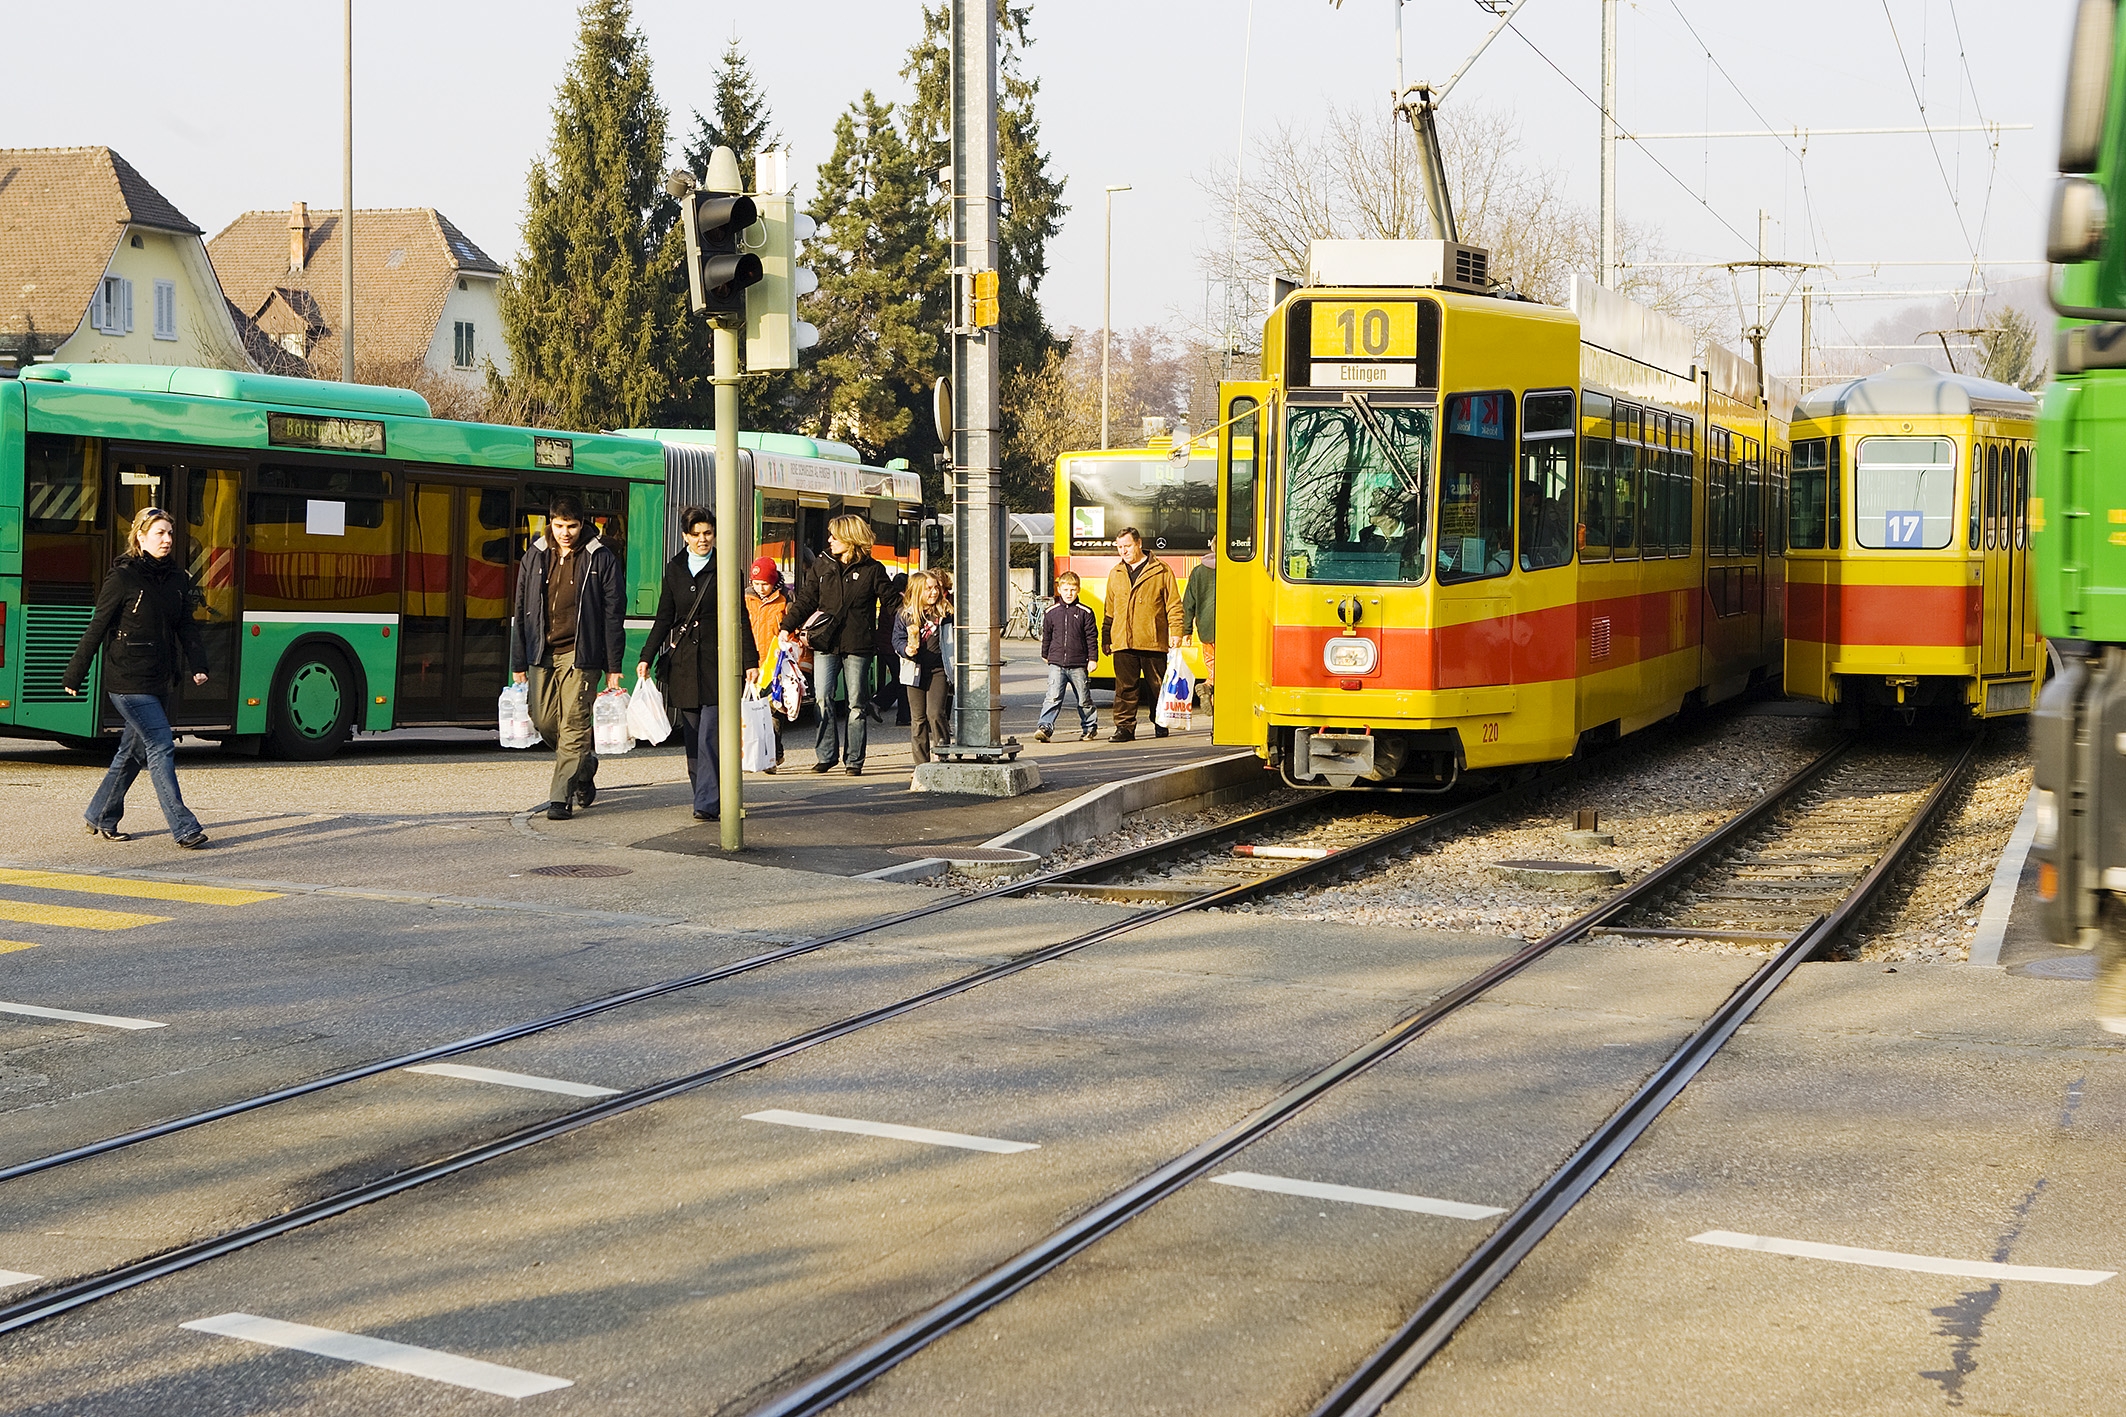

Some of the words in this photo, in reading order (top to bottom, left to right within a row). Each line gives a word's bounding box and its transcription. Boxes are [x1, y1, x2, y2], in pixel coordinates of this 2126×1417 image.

[1337, 308, 1390, 356] 10
[1340, 365, 1387, 383] Ettingen
[1889, 516, 1920, 542] 17
[1164, 701, 1193, 713] JUMBO
[1483, 722, 1499, 743] 220
